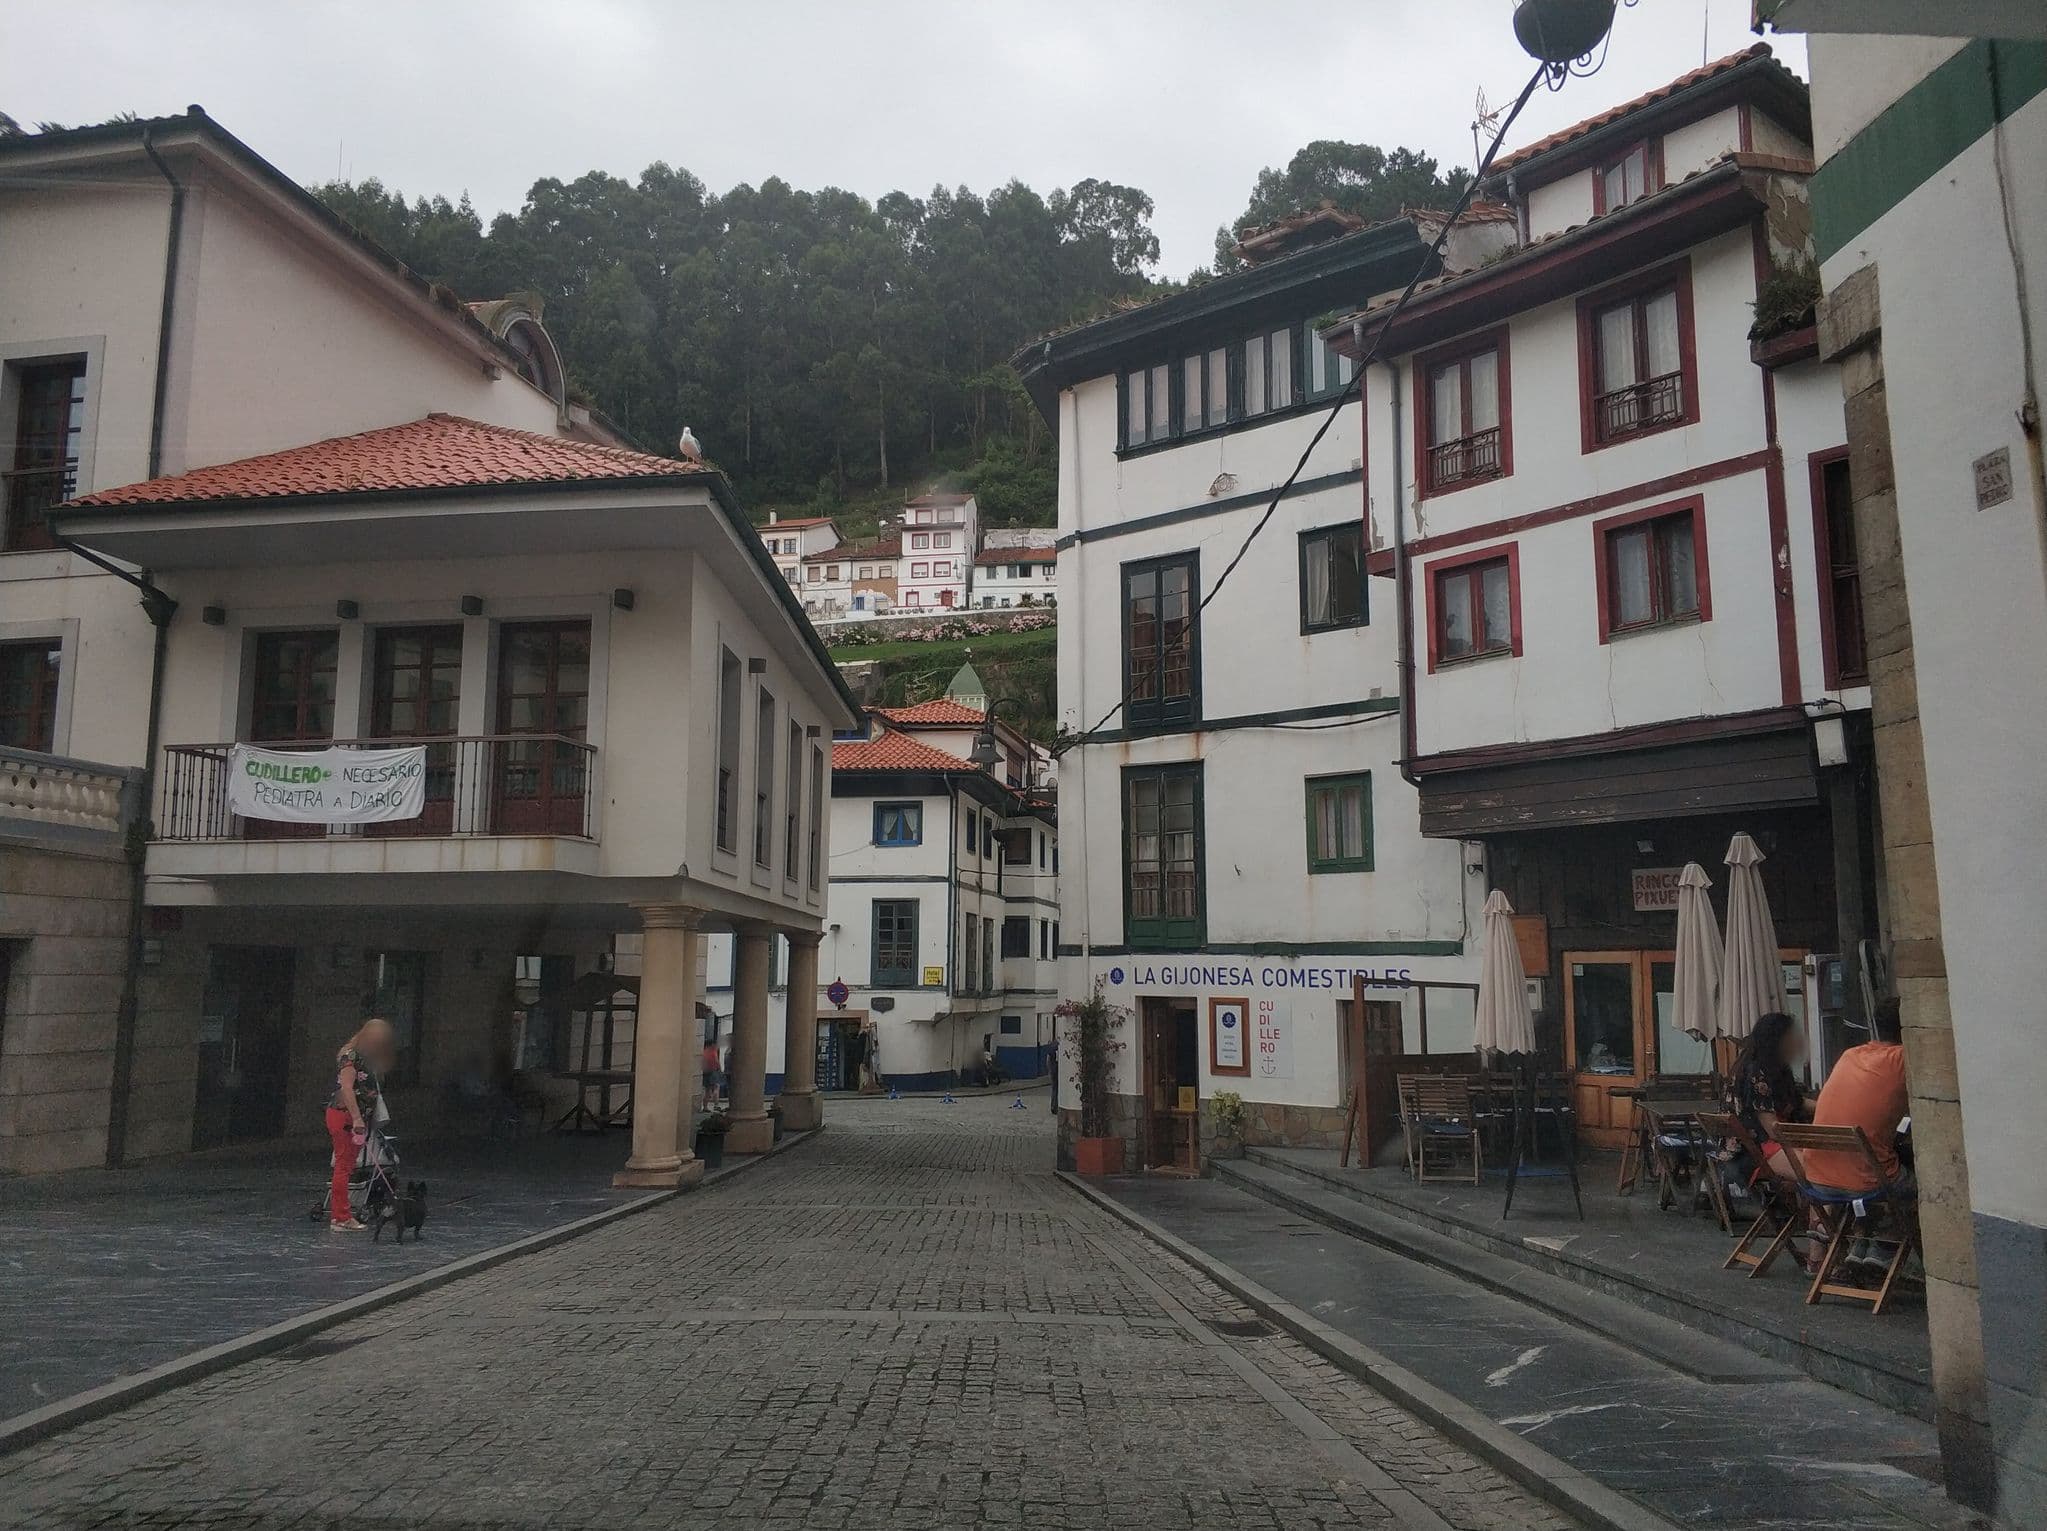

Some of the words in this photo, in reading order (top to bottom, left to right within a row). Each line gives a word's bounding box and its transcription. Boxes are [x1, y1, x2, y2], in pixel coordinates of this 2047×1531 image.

[343, 763, 421, 783] NECESARIO
[254, 781, 323, 808] PEDIATRA
[350, 788, 403, 809] DIARIO
[1635, 873, 1681, 890] RINCO
[1635, 889, 1680, 906] PIXUE
[1134, 966, 1156, 985] LA
[1161, 966, 1254, 986] GIJONESA
[1259, 1000, 1274, 1012] CU
[1259, 1014, 1270, 1026] DI
[1260, 1028, 1281, 1040] LLE
[1260, 1042, 1275, 1053] RO
